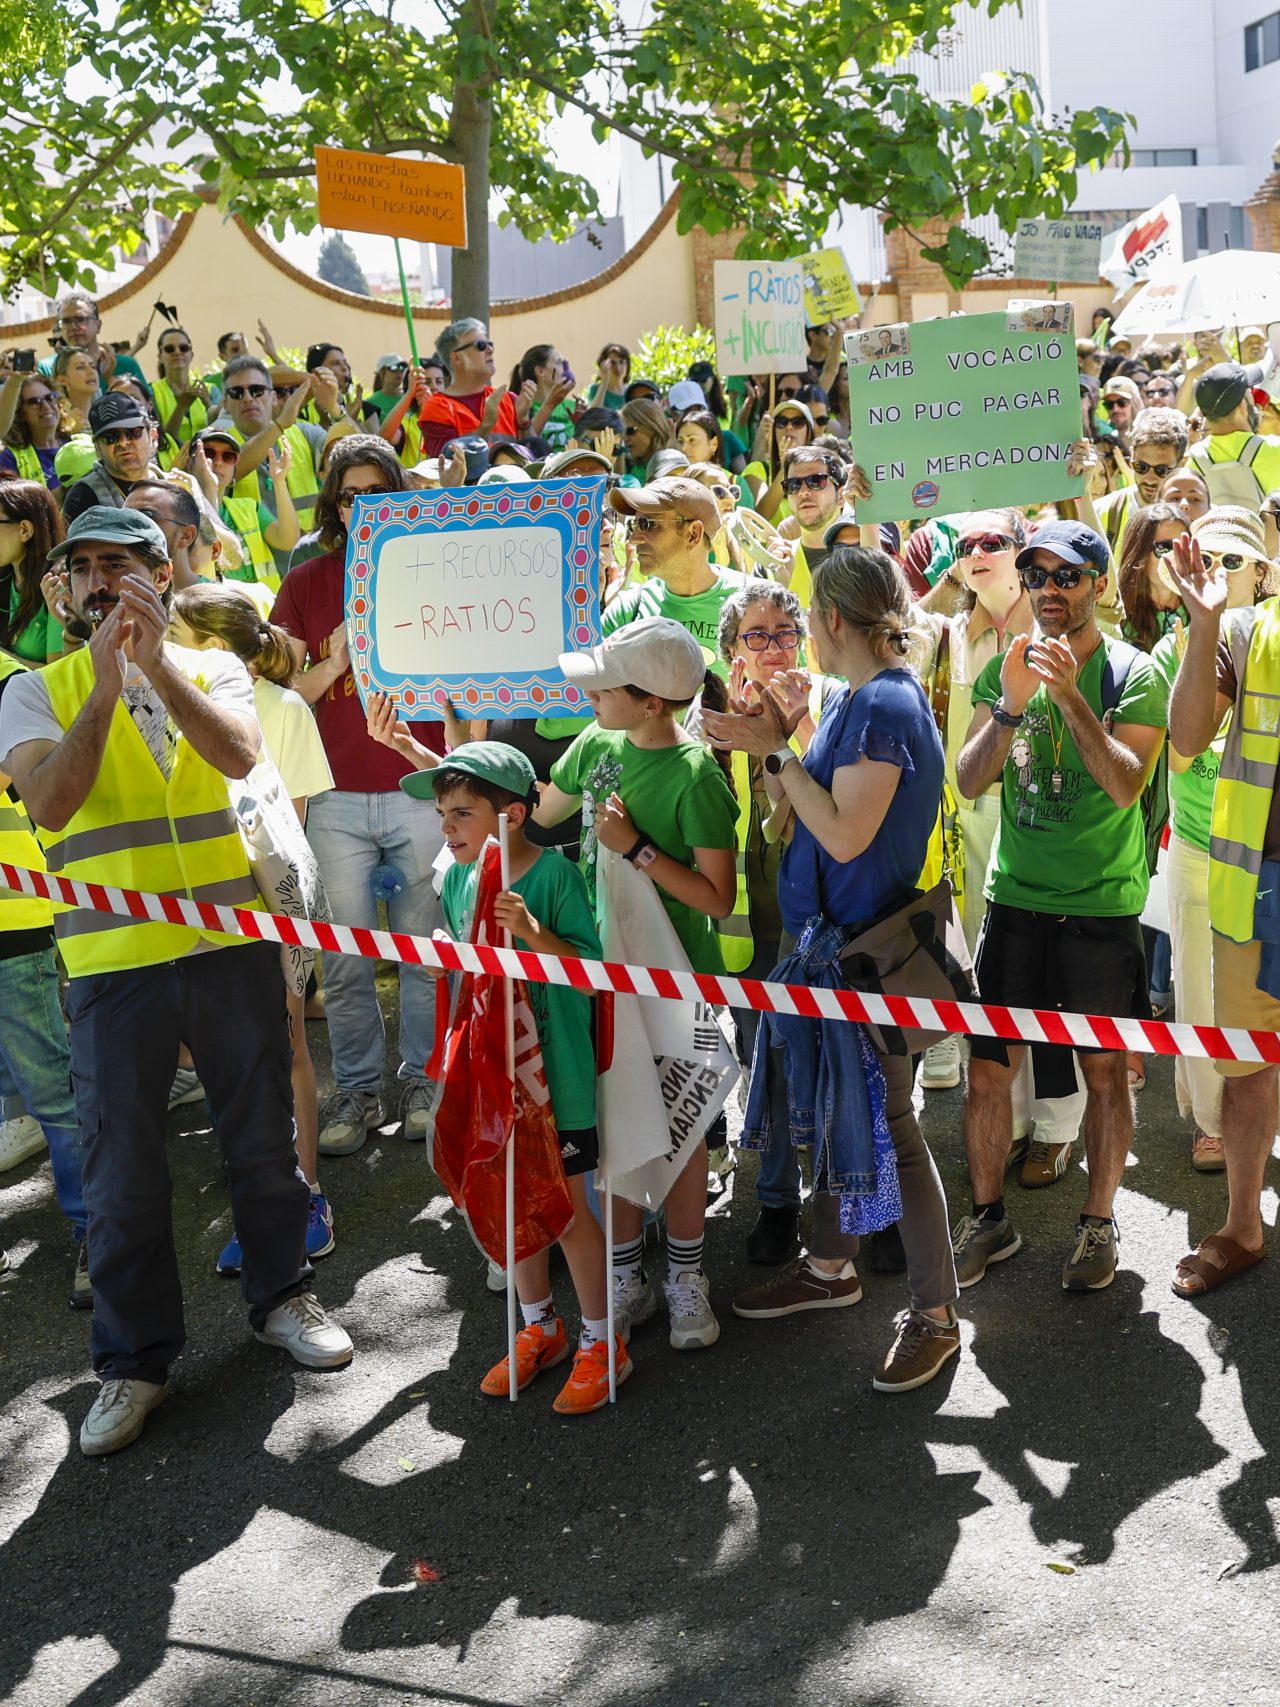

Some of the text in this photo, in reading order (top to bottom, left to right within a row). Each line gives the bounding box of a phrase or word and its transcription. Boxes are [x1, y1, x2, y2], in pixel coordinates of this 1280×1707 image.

[325, 153, 420, 180] Las maestras
[327, 170, 454, 201] LUCHANDO también
[330, 187, 455, 221] están ENSEÑANDO
[1020, 222, 1102, 240] JO FAIG VAGA
[748, 266, 801, 305] RÀTIOS
[858, 332, 870, 343] 75
[850, 357, 859, 365] 75
[868, 338, 1062, 381] AMB VOCACIÓ
[869, 388, 1060, 425] NO PUC PAGAR
[874, 443, 1073, 482] EN MERCADONA
[442, 538, 559, 580] RECURSOS
[420, 597, 536, 640] RATIOS
[561, 1148, 581, 1159] adidas
